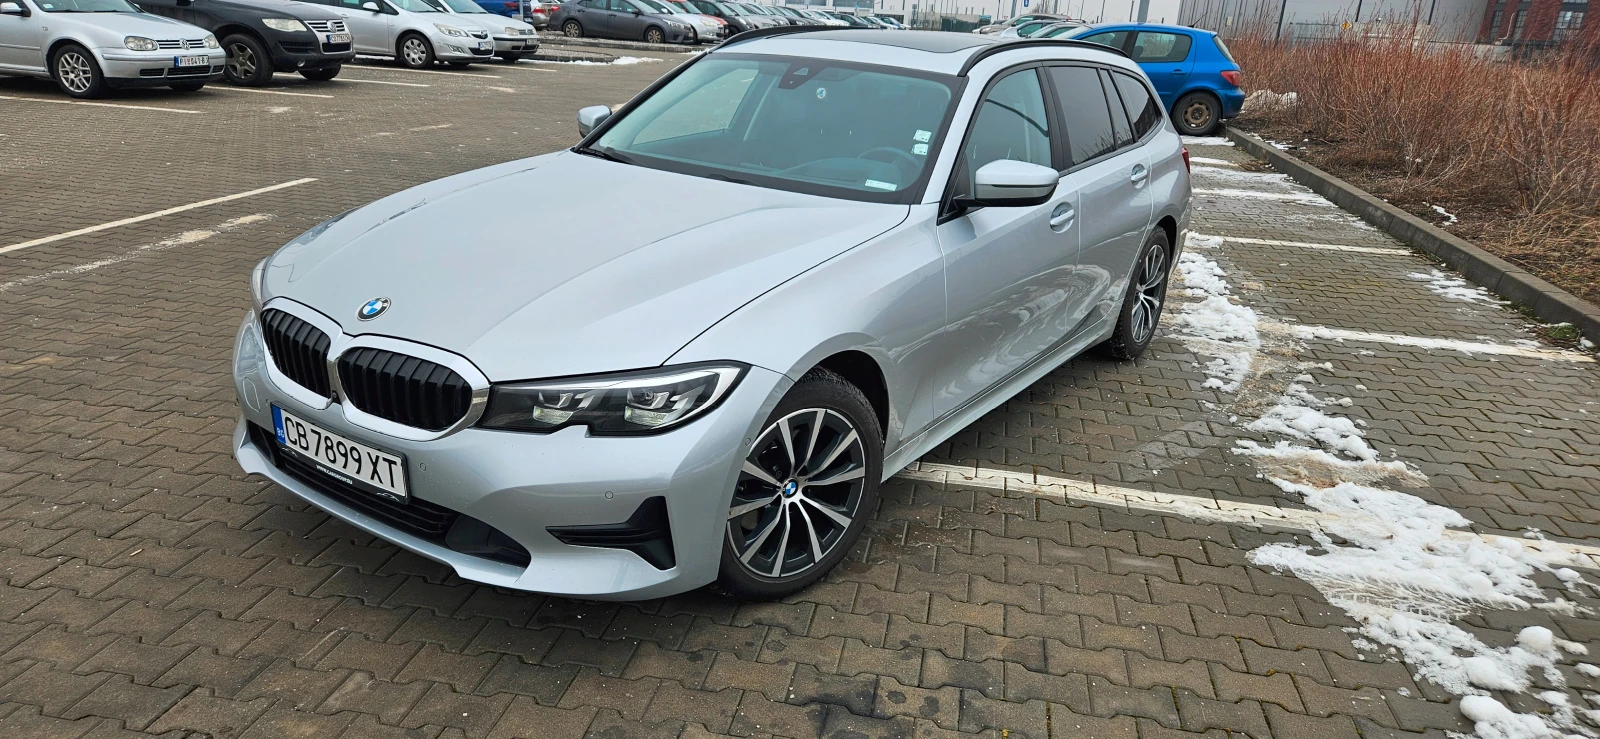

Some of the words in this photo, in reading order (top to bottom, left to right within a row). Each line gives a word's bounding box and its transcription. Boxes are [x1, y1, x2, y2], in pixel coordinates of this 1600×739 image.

[284, 416, 309, 452] CB
[310, 428, 362, 475] 7899
[366, 451, 398, 489] XT
